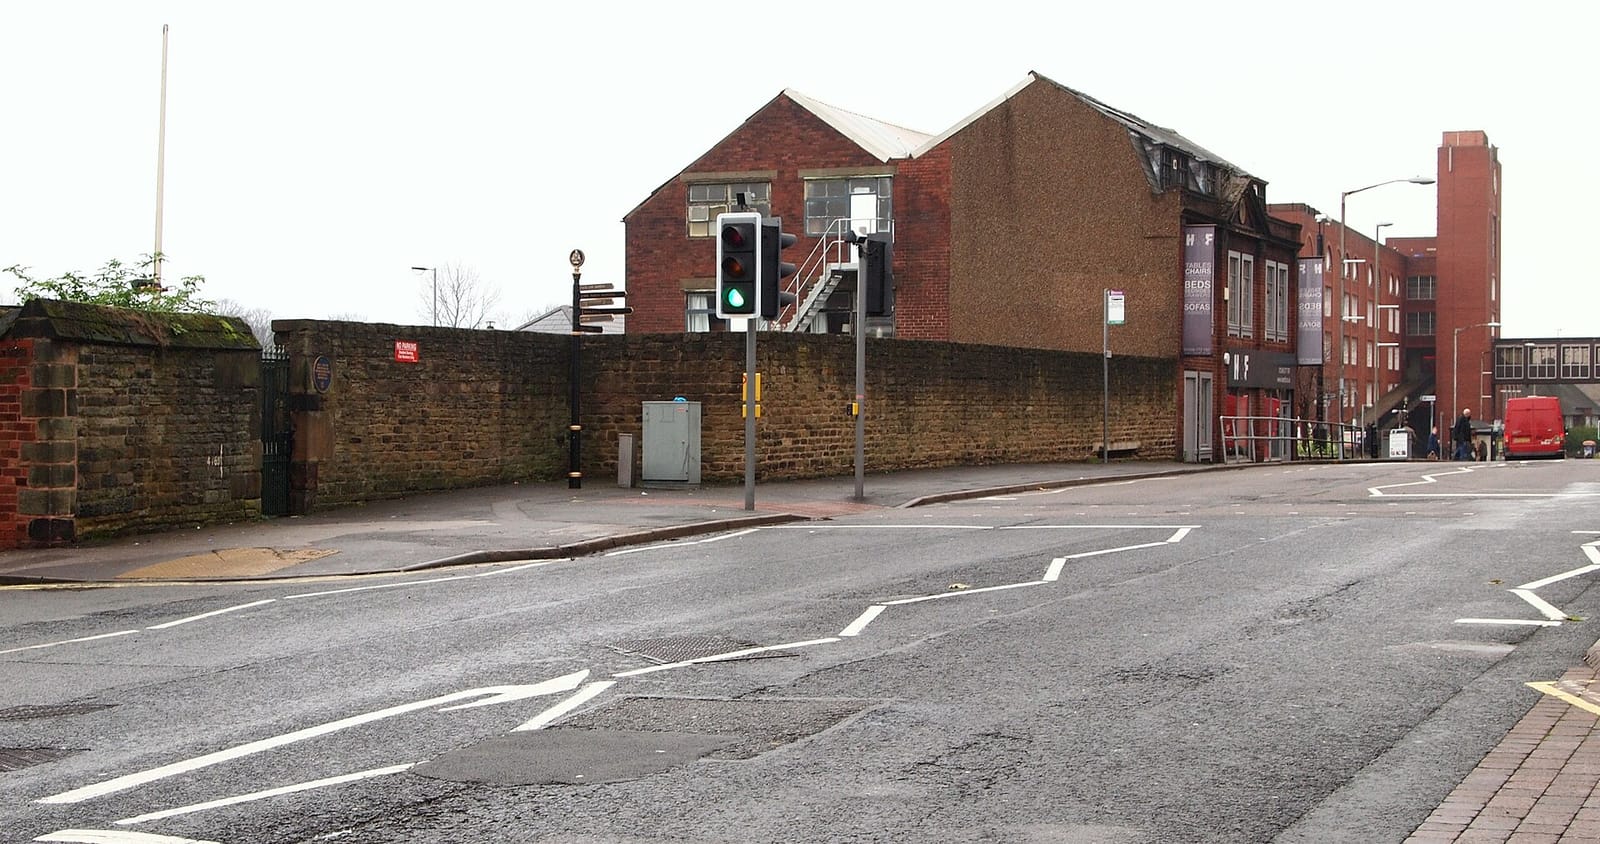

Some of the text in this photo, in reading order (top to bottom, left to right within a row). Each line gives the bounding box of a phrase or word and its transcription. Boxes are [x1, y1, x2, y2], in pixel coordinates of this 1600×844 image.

[1186, 234, 1195, 246] H
[1184, 280, 1212, 289] BEDS
[1184, 303, 1211, 311] SOFAS
